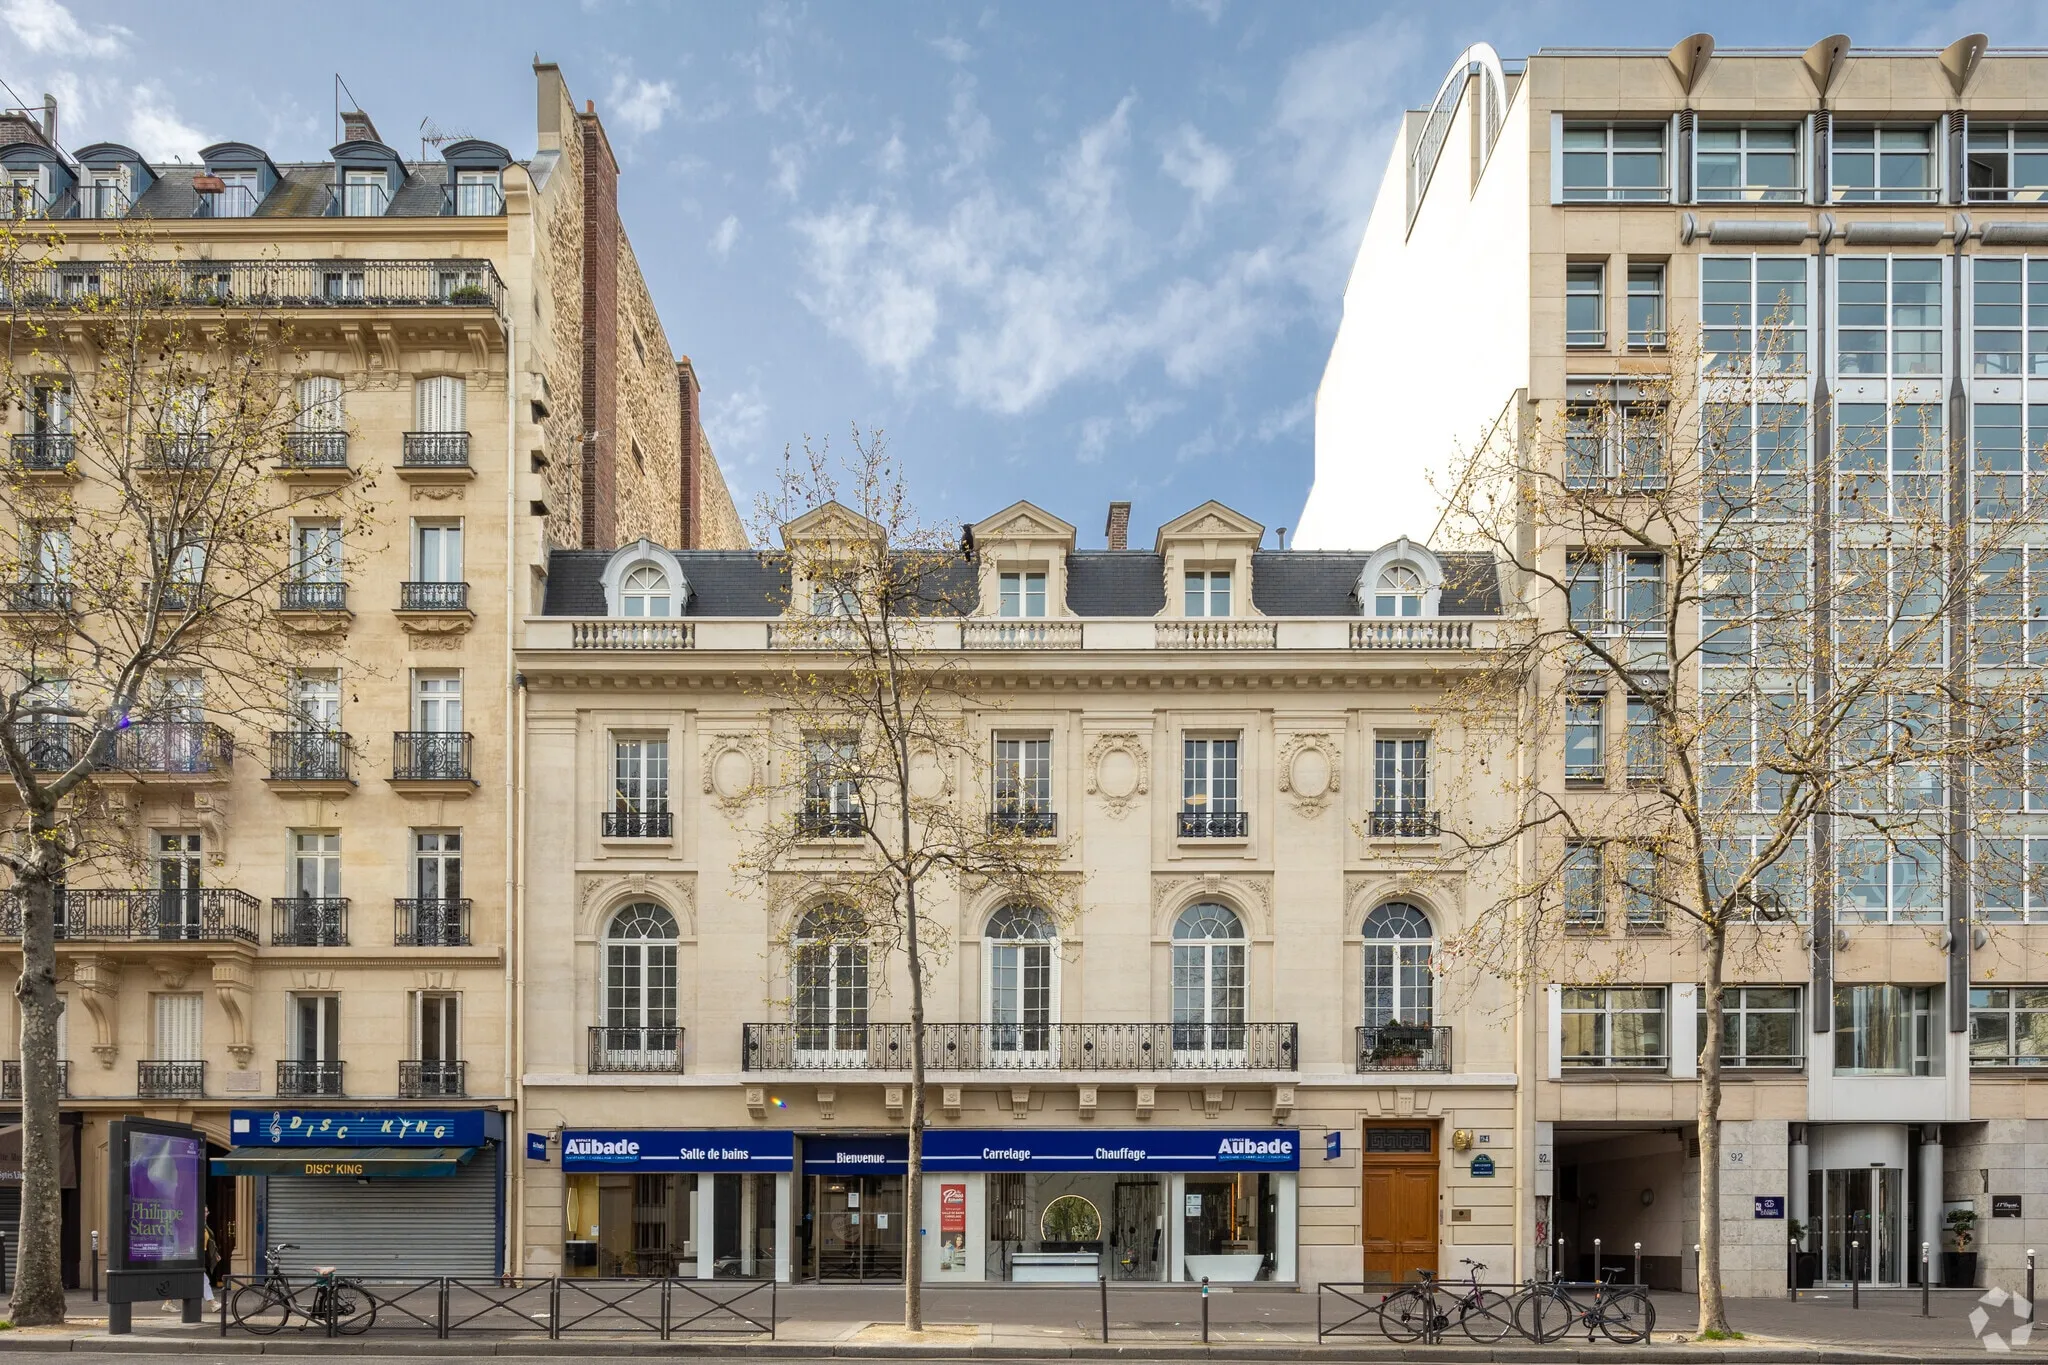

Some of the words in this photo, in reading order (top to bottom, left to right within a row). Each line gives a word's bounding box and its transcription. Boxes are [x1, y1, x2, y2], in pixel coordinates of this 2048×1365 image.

[381, 1117, 446, 1139] KING
[565, 1139, 640, 1154] Aubade
[1218, 1139, 1293, 1154] Aubade
[680, 1148, 705, 1159] Salle
[708, 1148, 720, 1159] de
[722, 1148, 749, 1159] bains
[836, 1152, 885, 1163] Bienvenue
[983, 1148, 1031, 1161] Carrelage
[1095, 1148, 1146, 1161] Chauffage
[1731, 1153, 1743, 1161] 92
[336, 1164, 363, 1174] KING
[132, 1203, 183, 1223] Philippe
[131, 1219, 174, 1235] Starck
